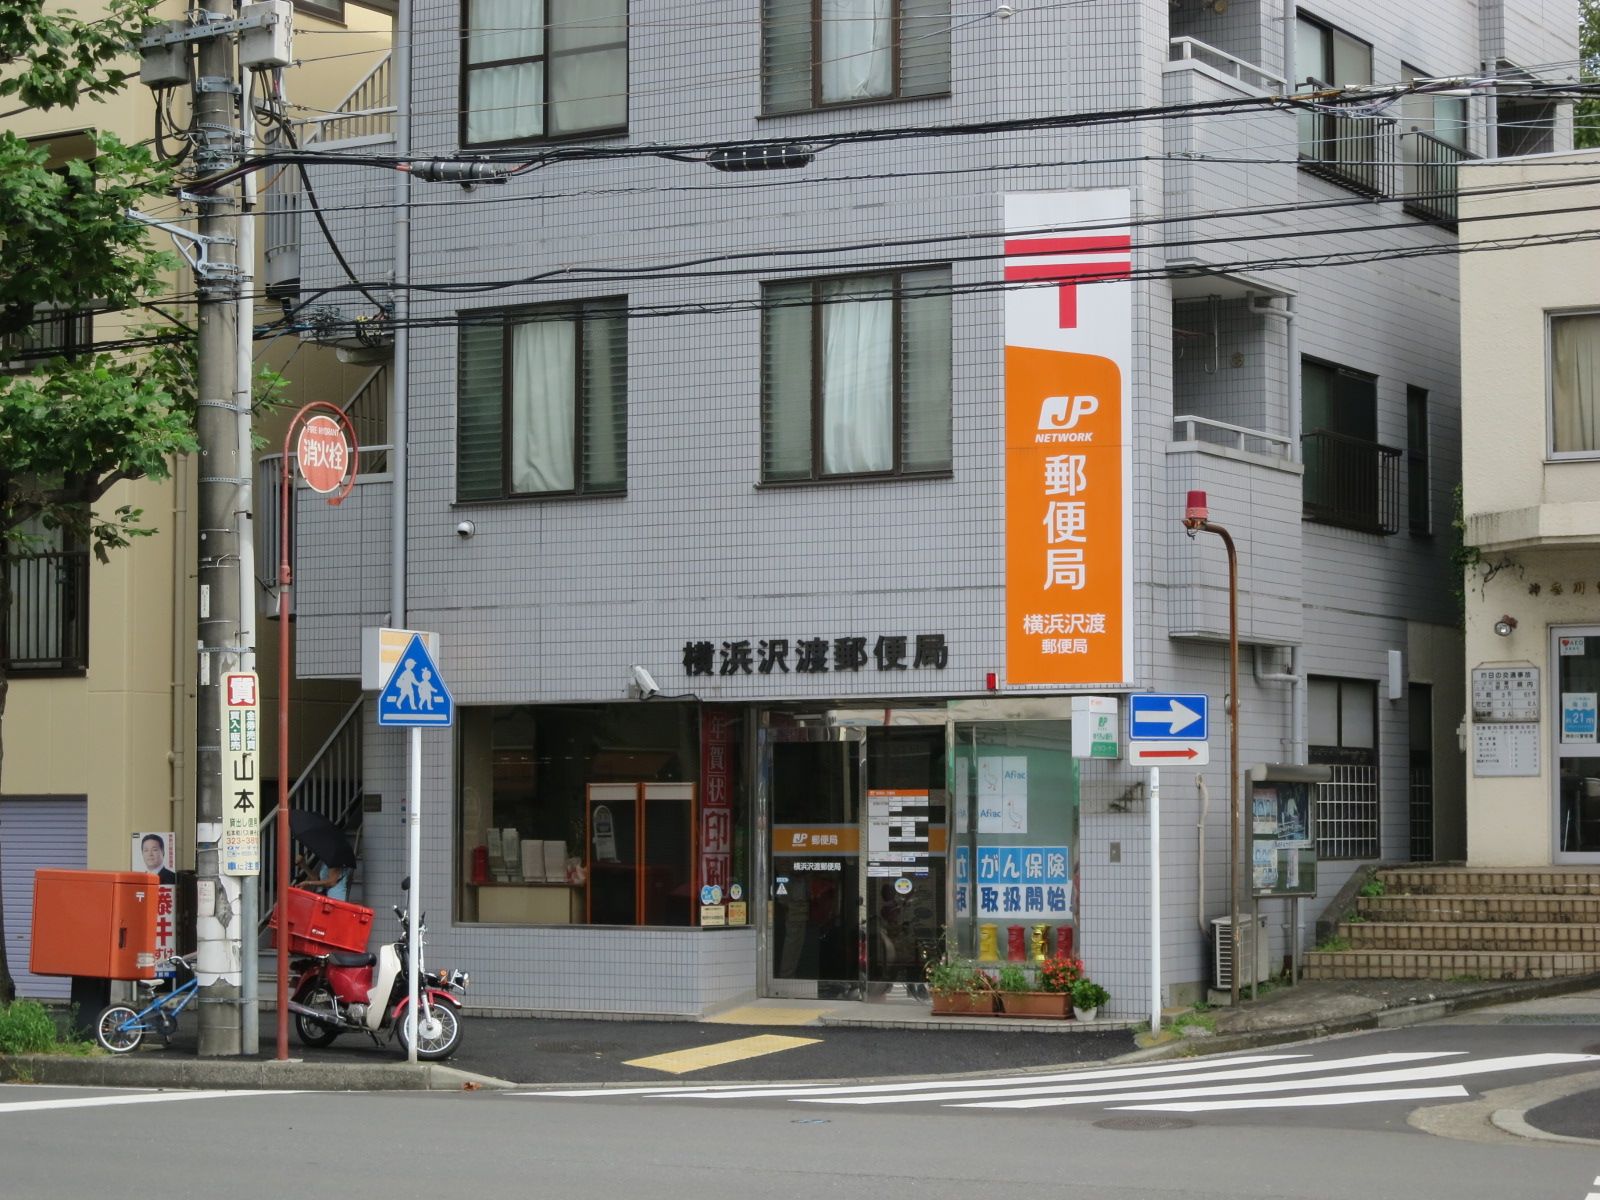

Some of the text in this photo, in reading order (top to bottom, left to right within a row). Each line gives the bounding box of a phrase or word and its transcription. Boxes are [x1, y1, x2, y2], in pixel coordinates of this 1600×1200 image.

[1038, 396, 1099, 430] JP
[1035, 433, 1094, 443] NETWORK
[303, 438, 343, 470] 消火栓
[1043, 454, 1088, 591] 郵便局
[1528, 581, 1600, 597] 神奈川
[1023, 613, 1106, 635] 横浜沢渡
[682, 634, 949, 676] 横浜沢渡郵便局
[1041, 638, 1088, 654] 郵便局
[234, 756, 254, 813] 山本
[981, 853, 1065, 879] がん保険
